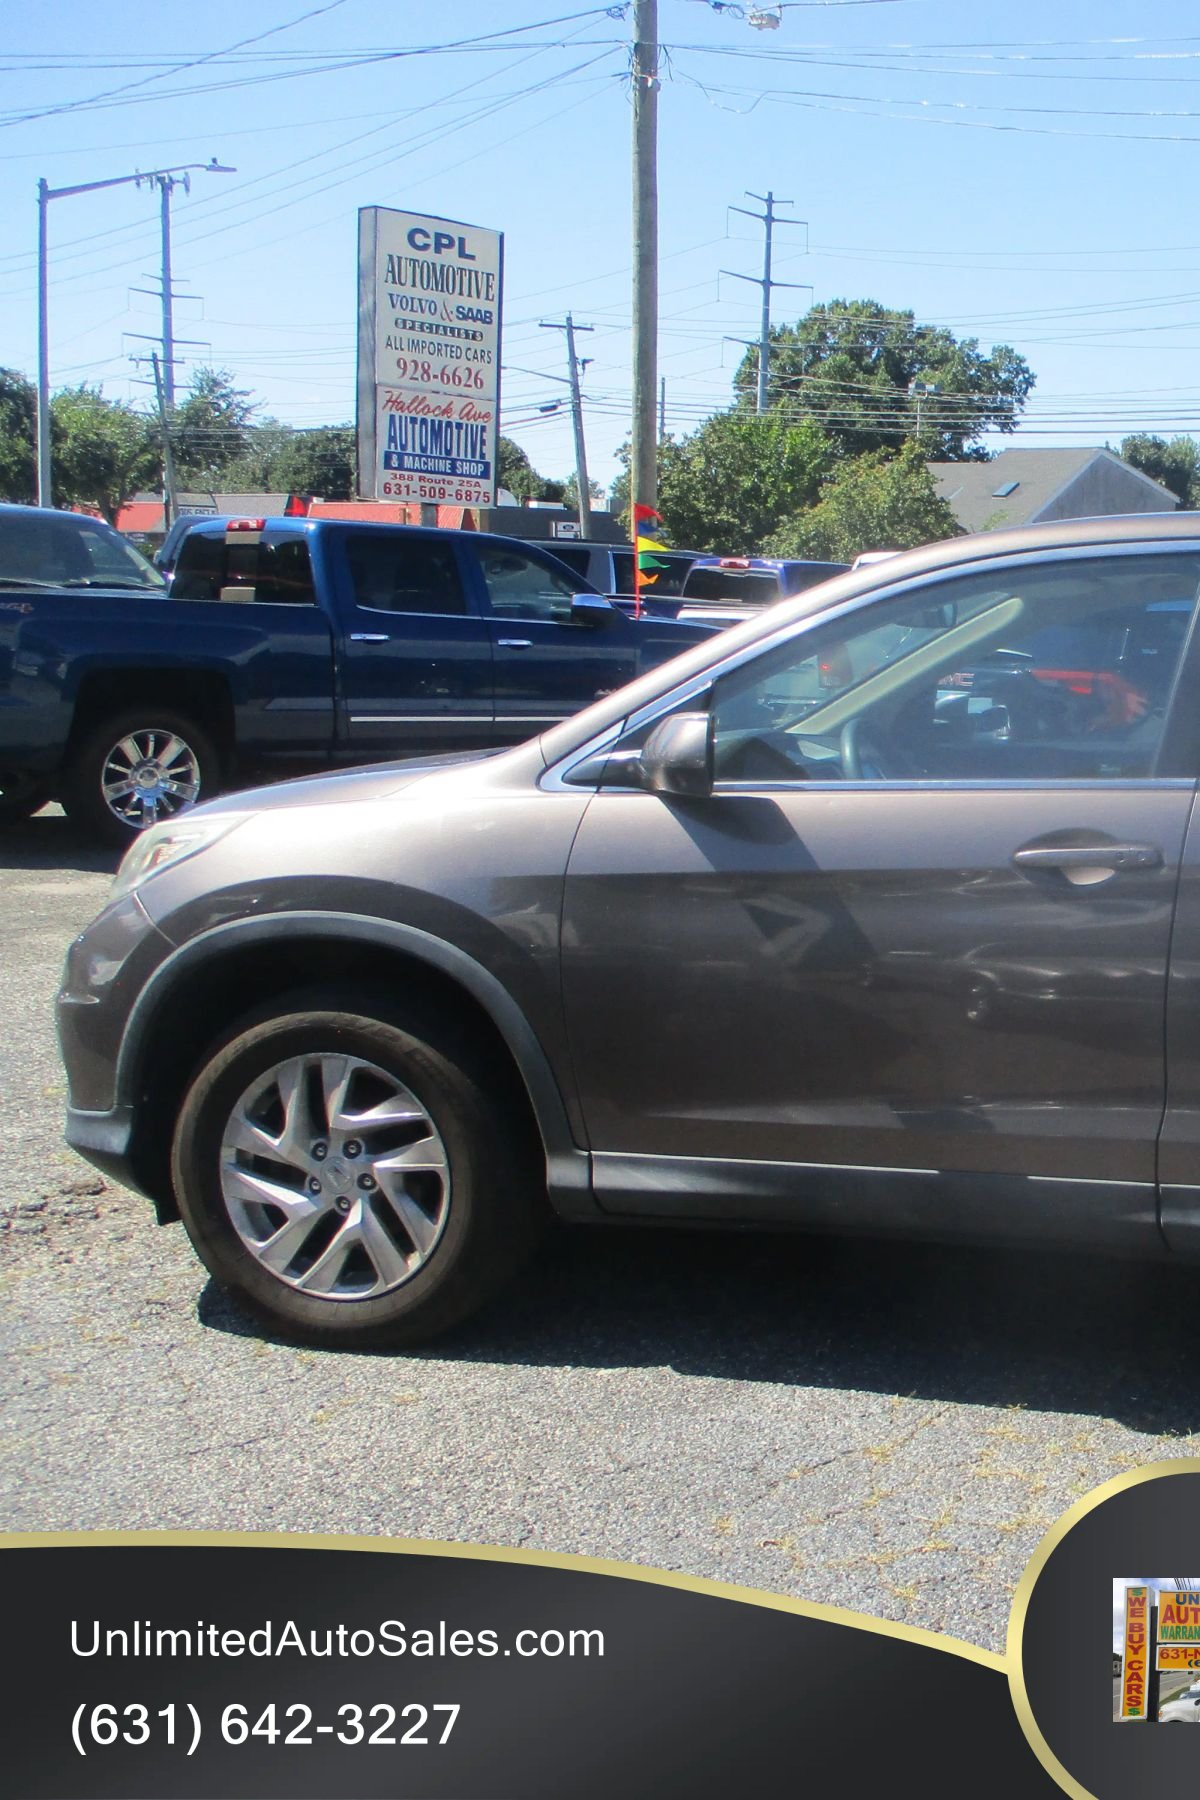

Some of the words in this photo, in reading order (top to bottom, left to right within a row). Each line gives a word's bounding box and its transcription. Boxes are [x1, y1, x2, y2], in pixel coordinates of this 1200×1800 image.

[407, 227, 476, 260] CPL
[384, 254, 495, 301] AUTOMOTIVE
[388, 293, 437, 316] VOLVO
[440, 300, 453, 322] &
[455, 305, 493, 325] SAAB
[396, 319, 483, 341] SPECIALISTS
[385, 335, 404, 351] ALL
[407, 337, 463, 360] IMPORTED
[465, 347, 492, 364] CARS
[396, 357, 484, 390] 928-6626
[382, 390, 454, 419] Hallock
[459, 402, 493, 423] Ave
[388, 414, 487, 460] AUTOMOTIVE
[390, 473, 414, 482] 388
[418, 476, 453, 486] Route
[458, 479, 481, 489] 25A
[391, 455, 399, 467] &
[404, 457, 451, 473] MACHINE
[456, 461, 485, 476] SHOP
[383, 482, 490, 504] 631-509-6875
